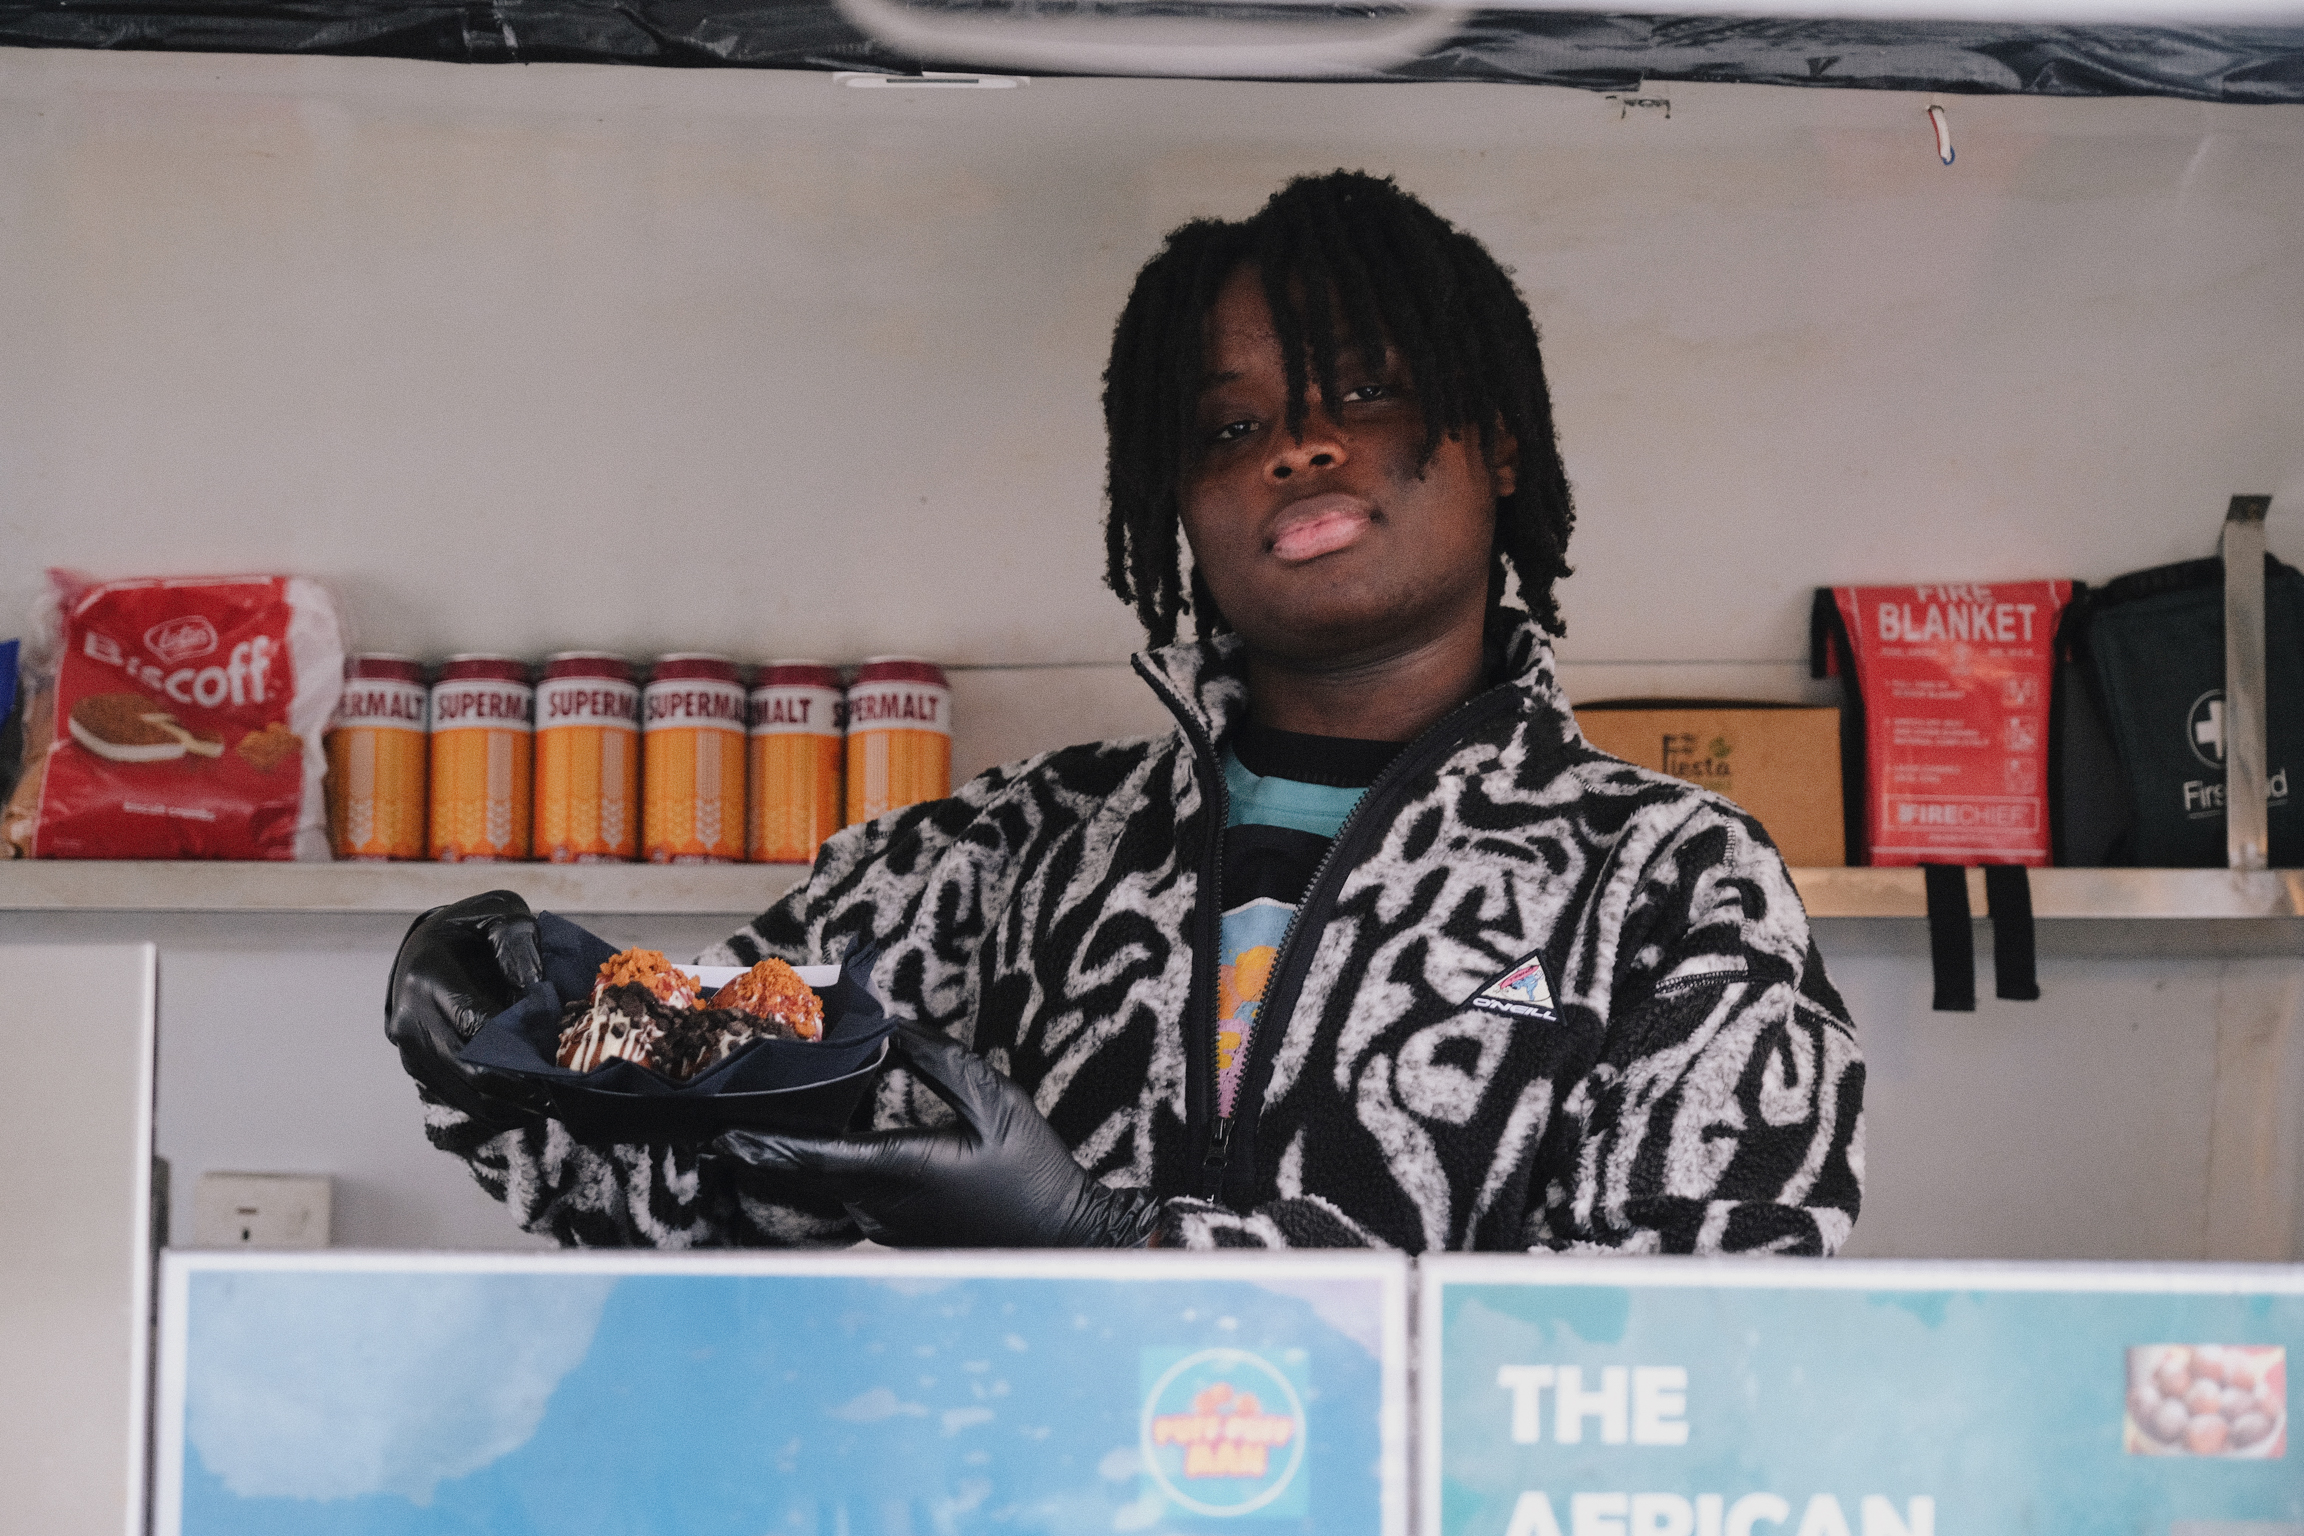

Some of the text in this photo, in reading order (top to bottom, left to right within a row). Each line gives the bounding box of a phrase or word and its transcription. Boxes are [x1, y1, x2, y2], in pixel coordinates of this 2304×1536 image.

[1878, 603, 2036, 642] BLANKET
[439, 692, 527, 720] SUPERM
[1497, 1364, 1690, 1445] THE
